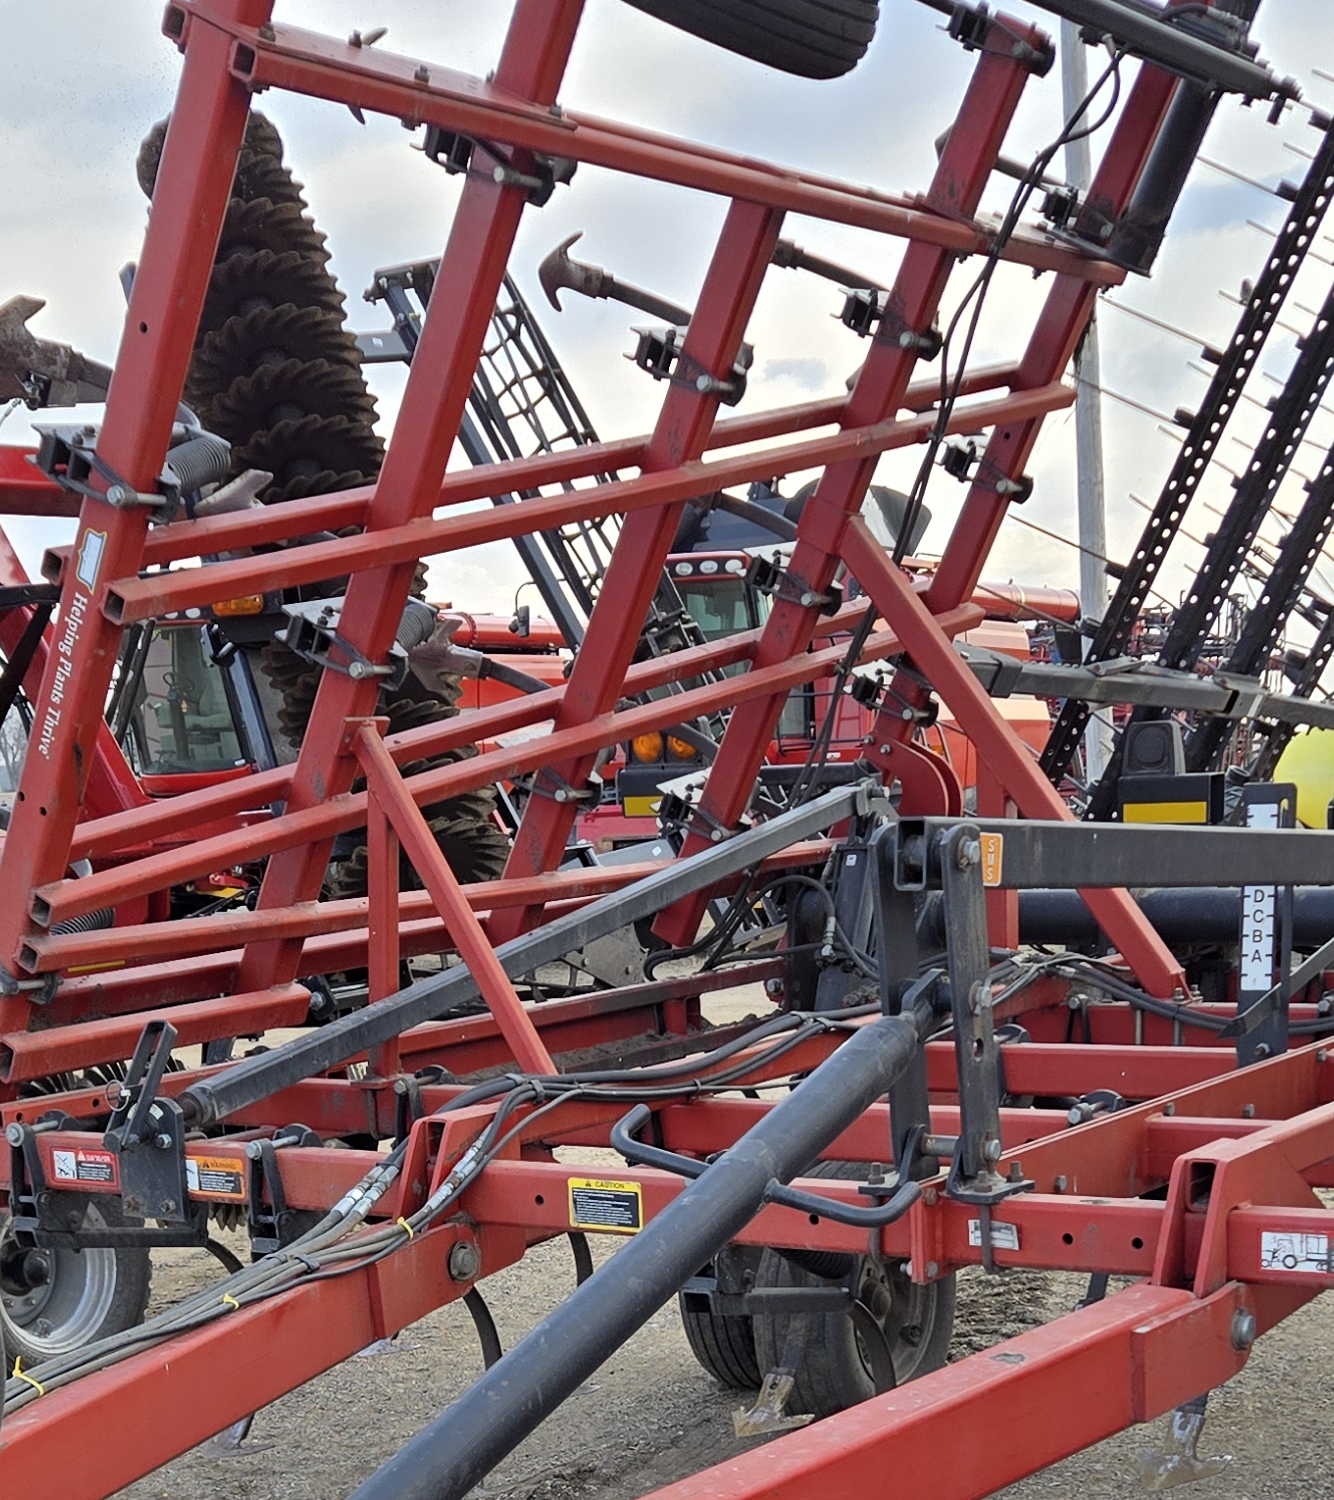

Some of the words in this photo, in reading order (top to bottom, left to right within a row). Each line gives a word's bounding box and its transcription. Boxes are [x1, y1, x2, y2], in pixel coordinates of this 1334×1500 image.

[58, 591, 88, 655] Helping
[51, 655, 73, 704] Plants
[1253, 889, 1265, 903] D
[1252, 909, 1264, 923] C
[1252, 929, 1263, 943] B
[1251, 949, 1262, 963] A
[595, 1181, 625, 1189] CAUTION
